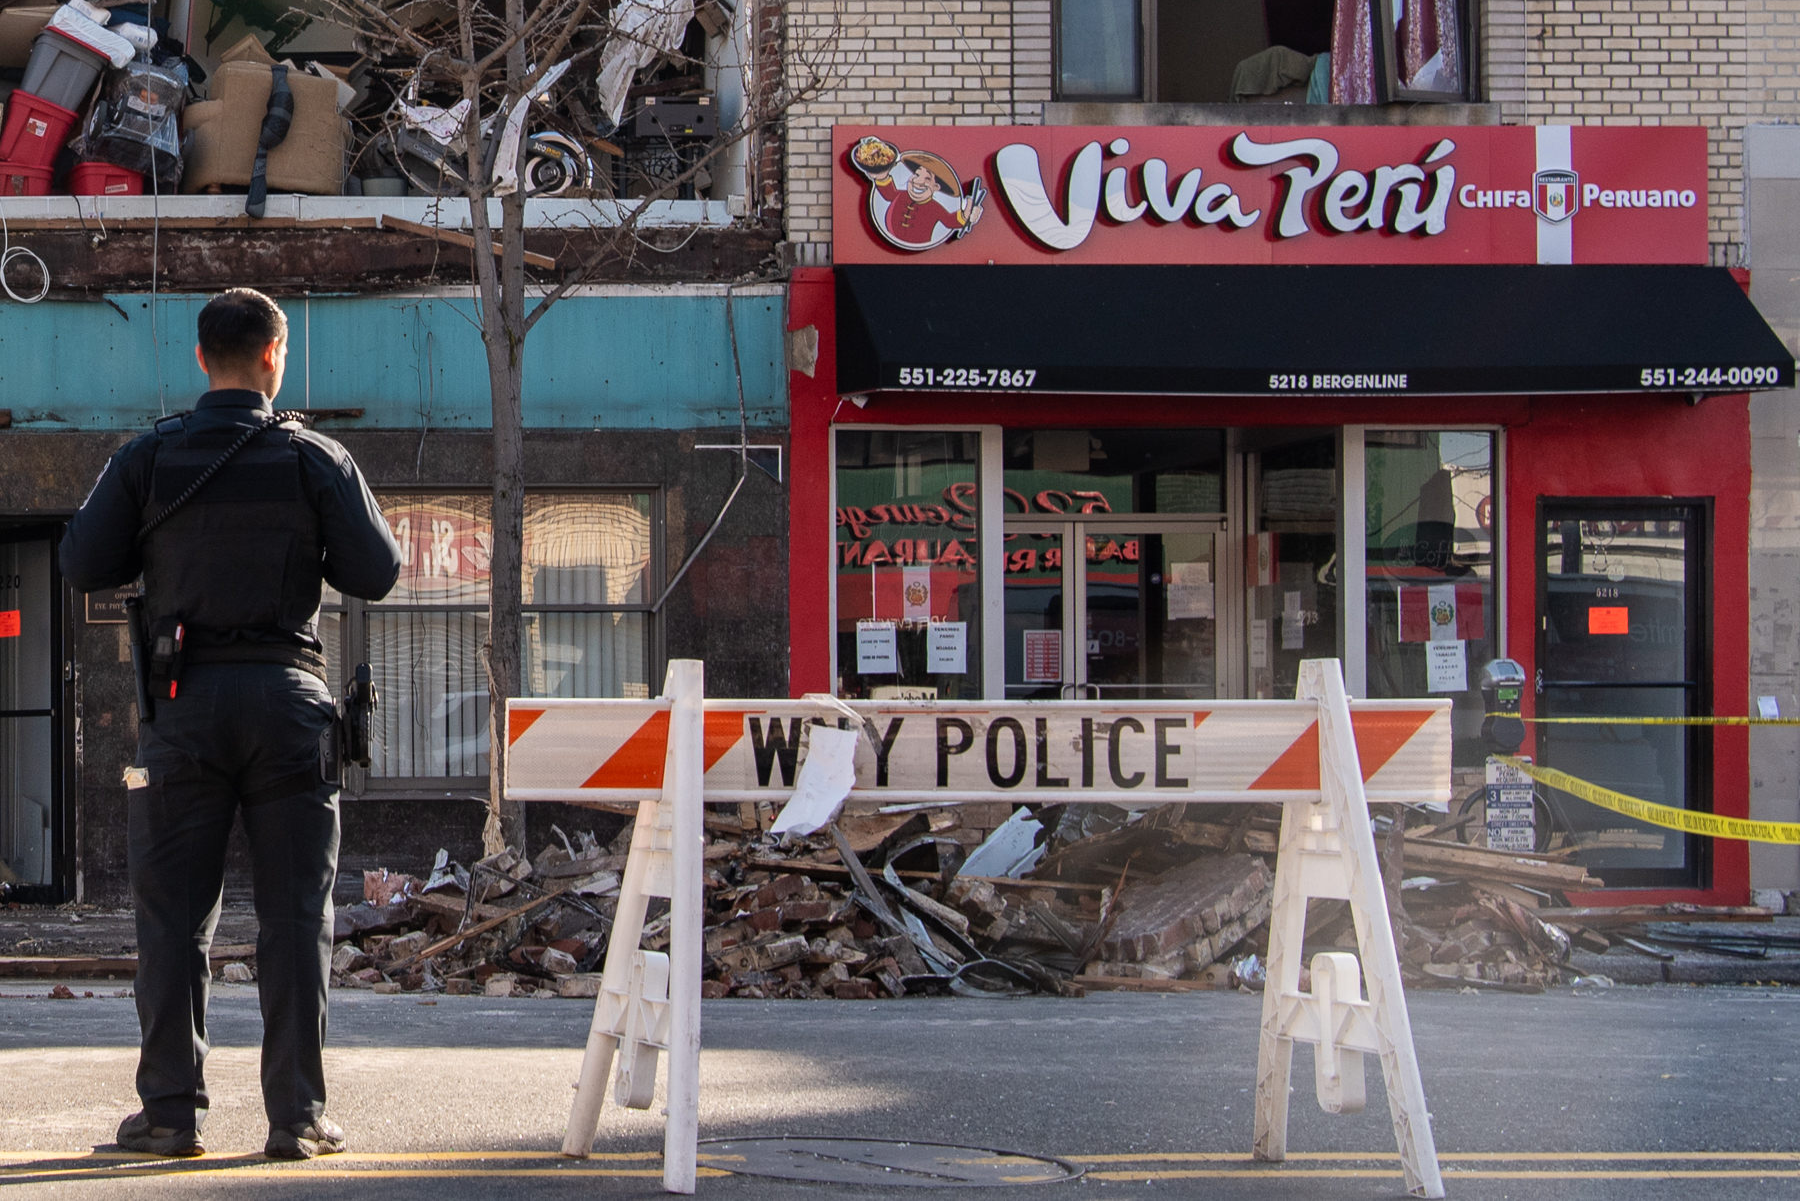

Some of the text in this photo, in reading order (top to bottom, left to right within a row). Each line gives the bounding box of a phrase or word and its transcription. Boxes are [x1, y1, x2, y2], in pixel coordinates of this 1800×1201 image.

[996, 131, 1457, 251] Viva Perú
[899, 368, 1036, 387] 551-225-7867
[1269, 374, 1407, 390] 5218 BERGENLINE
[1640, 367, 1778, 386] 551-244-0090
[1596, 588, 1619, 598] 5218
[748, 716, 1189, 788] WY POLICE
[1490, 791, 1496, 801] 3
